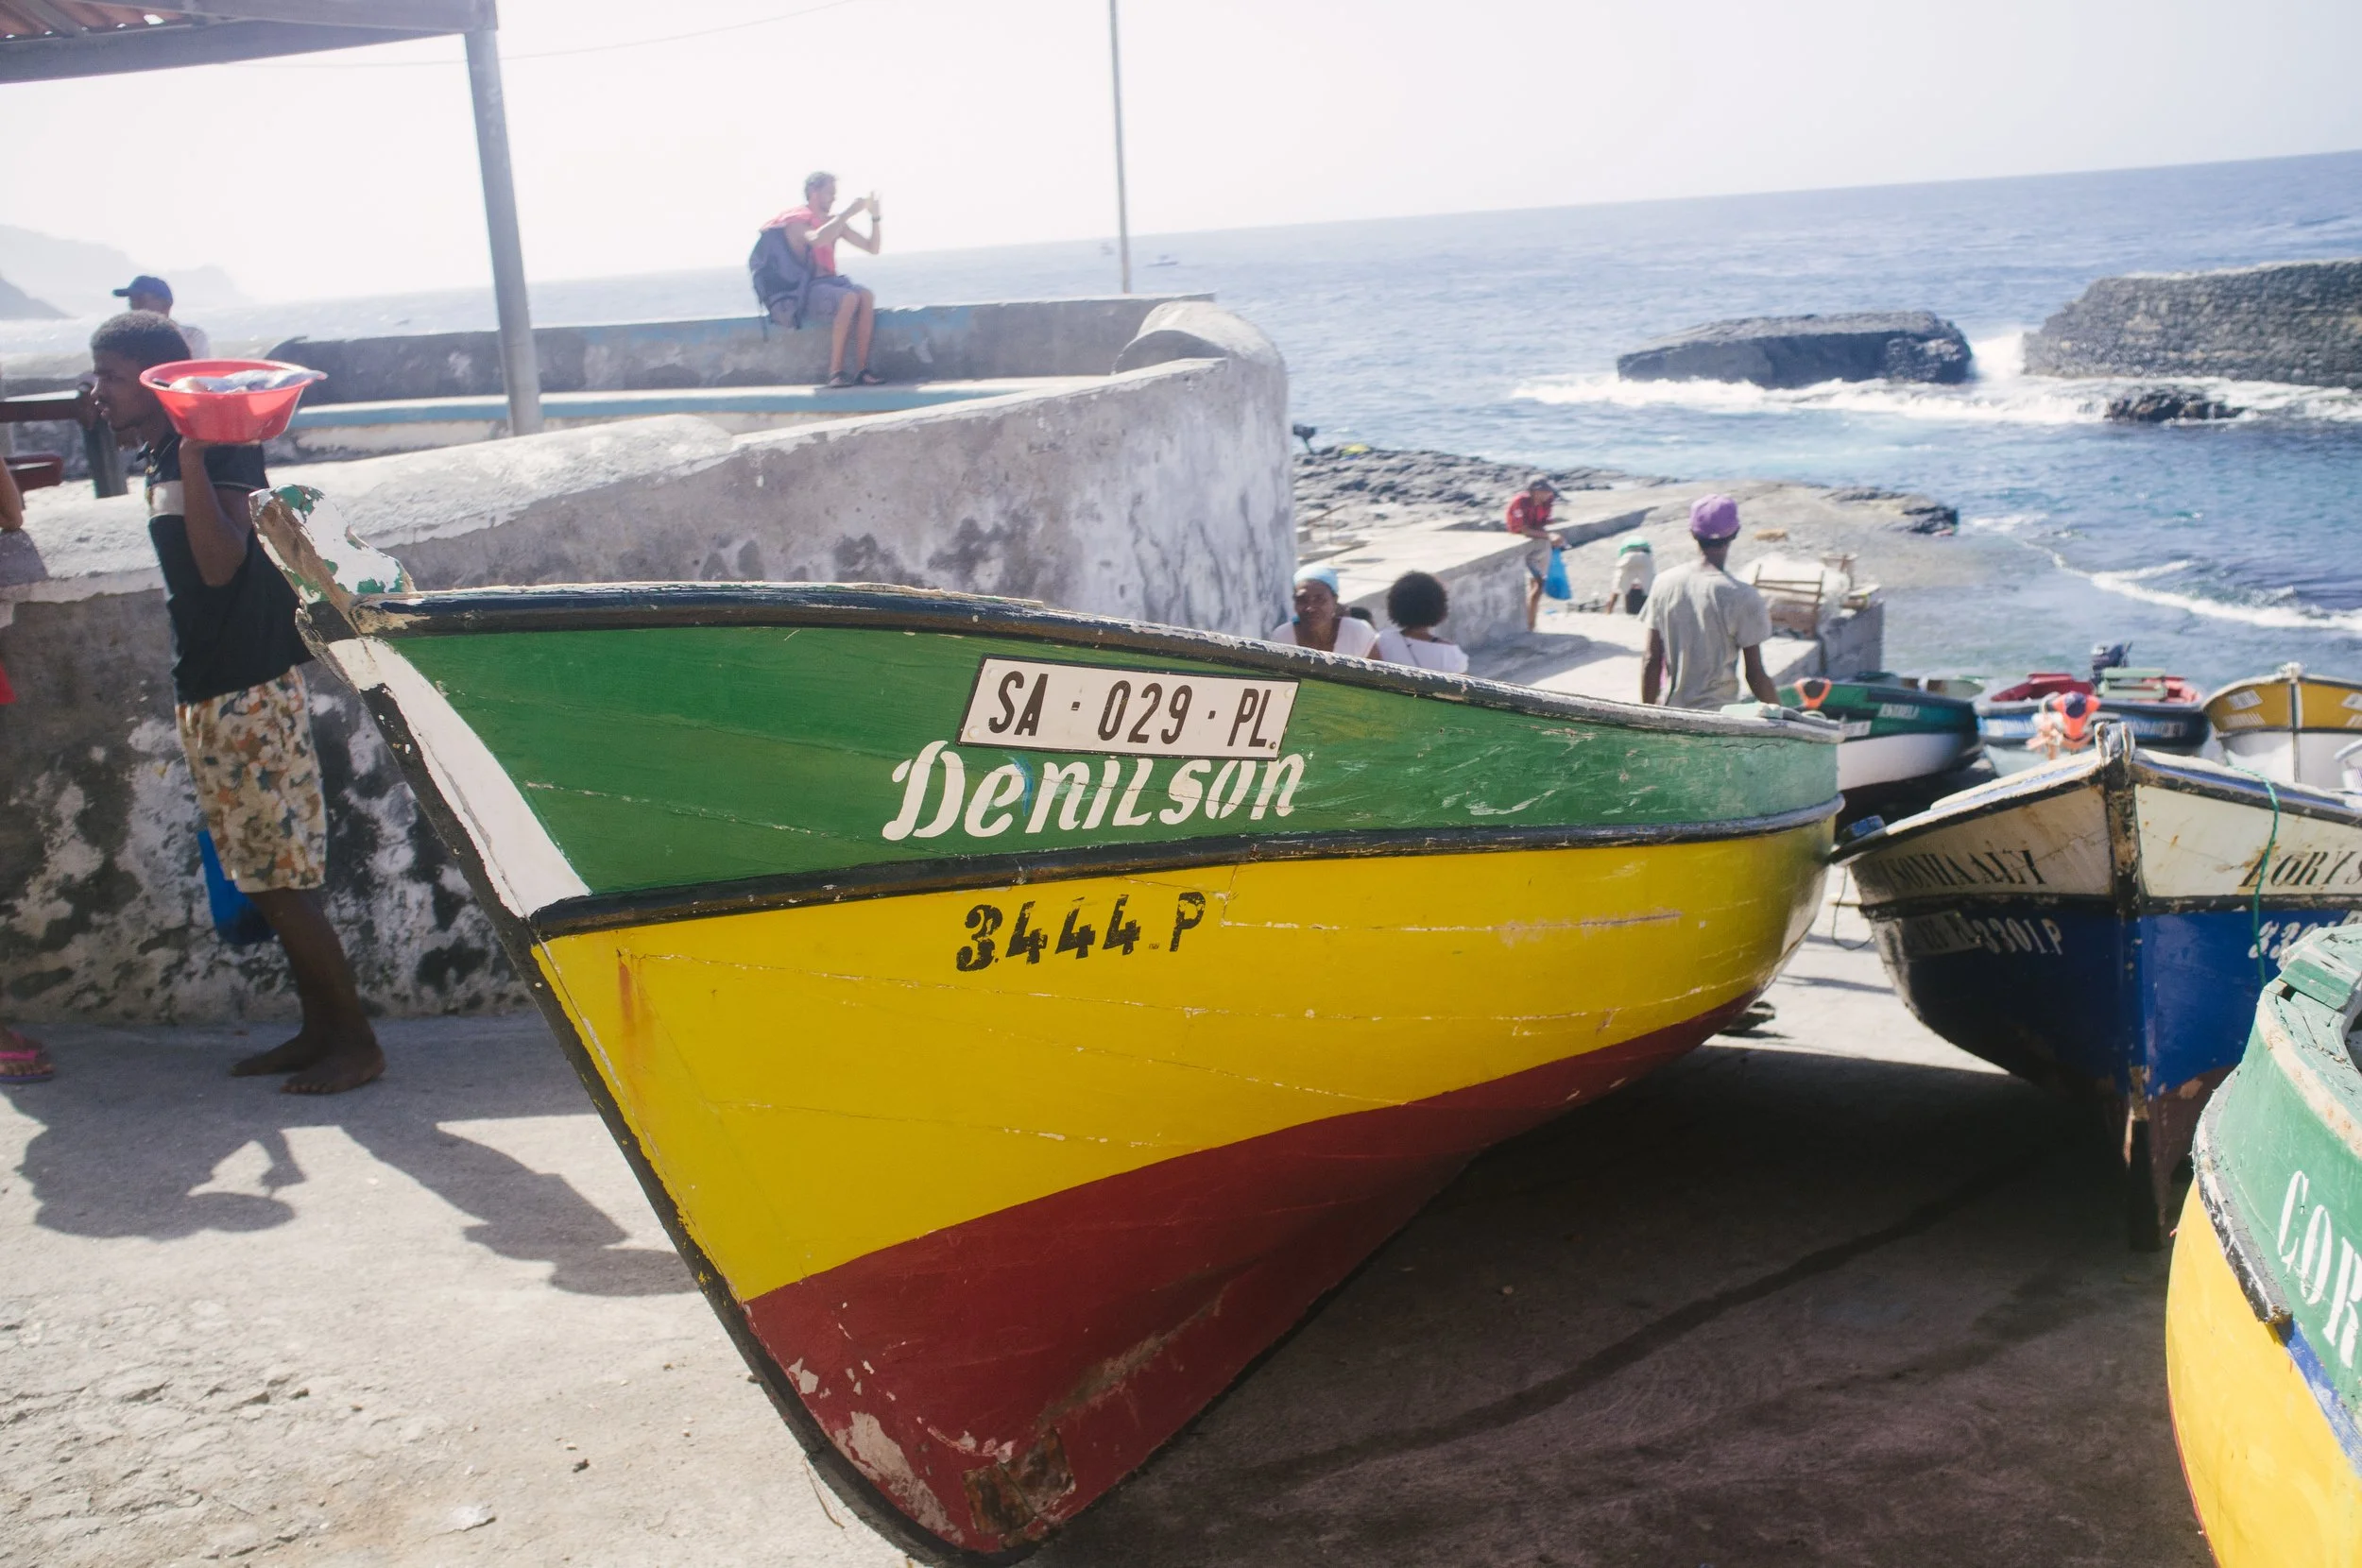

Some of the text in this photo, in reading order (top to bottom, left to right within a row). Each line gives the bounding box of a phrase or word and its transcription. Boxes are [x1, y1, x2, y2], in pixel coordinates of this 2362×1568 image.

[988, 671, 1049, 737] SA
[1097, 680, 1193, 745] 029
[1169, 891, 1207, 952] P
